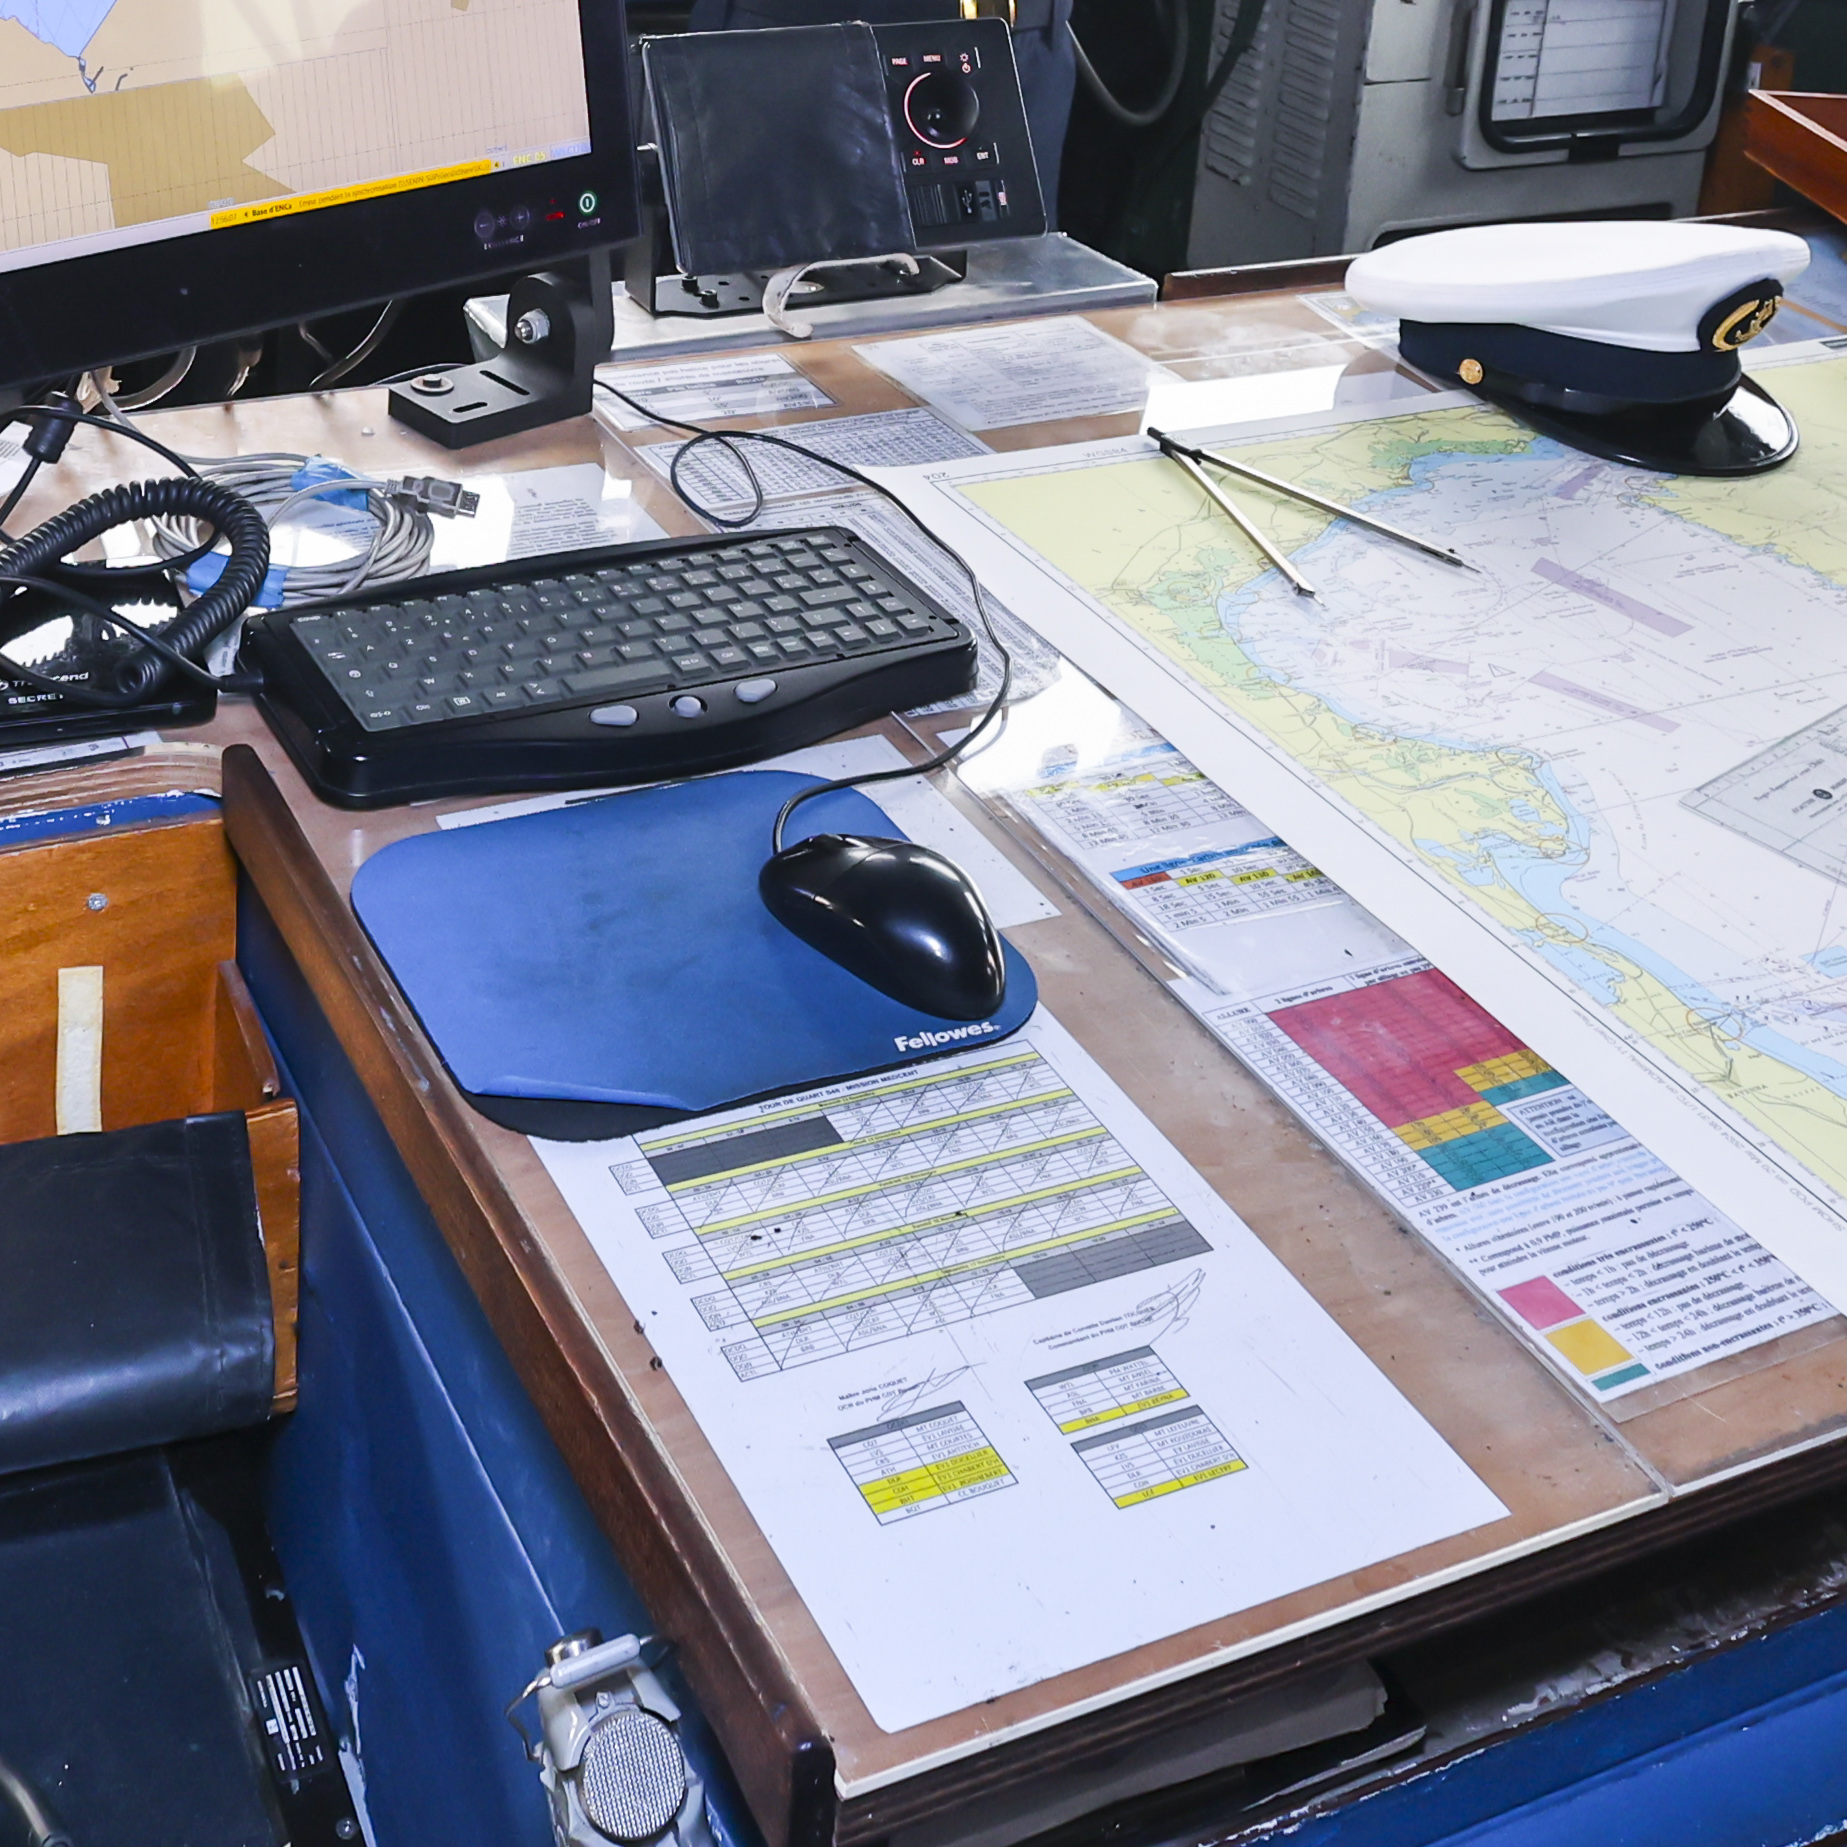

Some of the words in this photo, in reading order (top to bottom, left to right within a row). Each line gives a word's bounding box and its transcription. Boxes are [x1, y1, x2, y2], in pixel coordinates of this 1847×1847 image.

[252, 209, 268, 217] Base
[894, 1022, 994, 1052] Fellowes
[797, 1091, 824, 1104] QUART
[847, 1078, 880, 1095] MISSION
[1552, 1257, 1597, 1278] conditions
[1598, 1251, 1613, 1264] très
[1602, 1301, 1646, 1323] conditions
